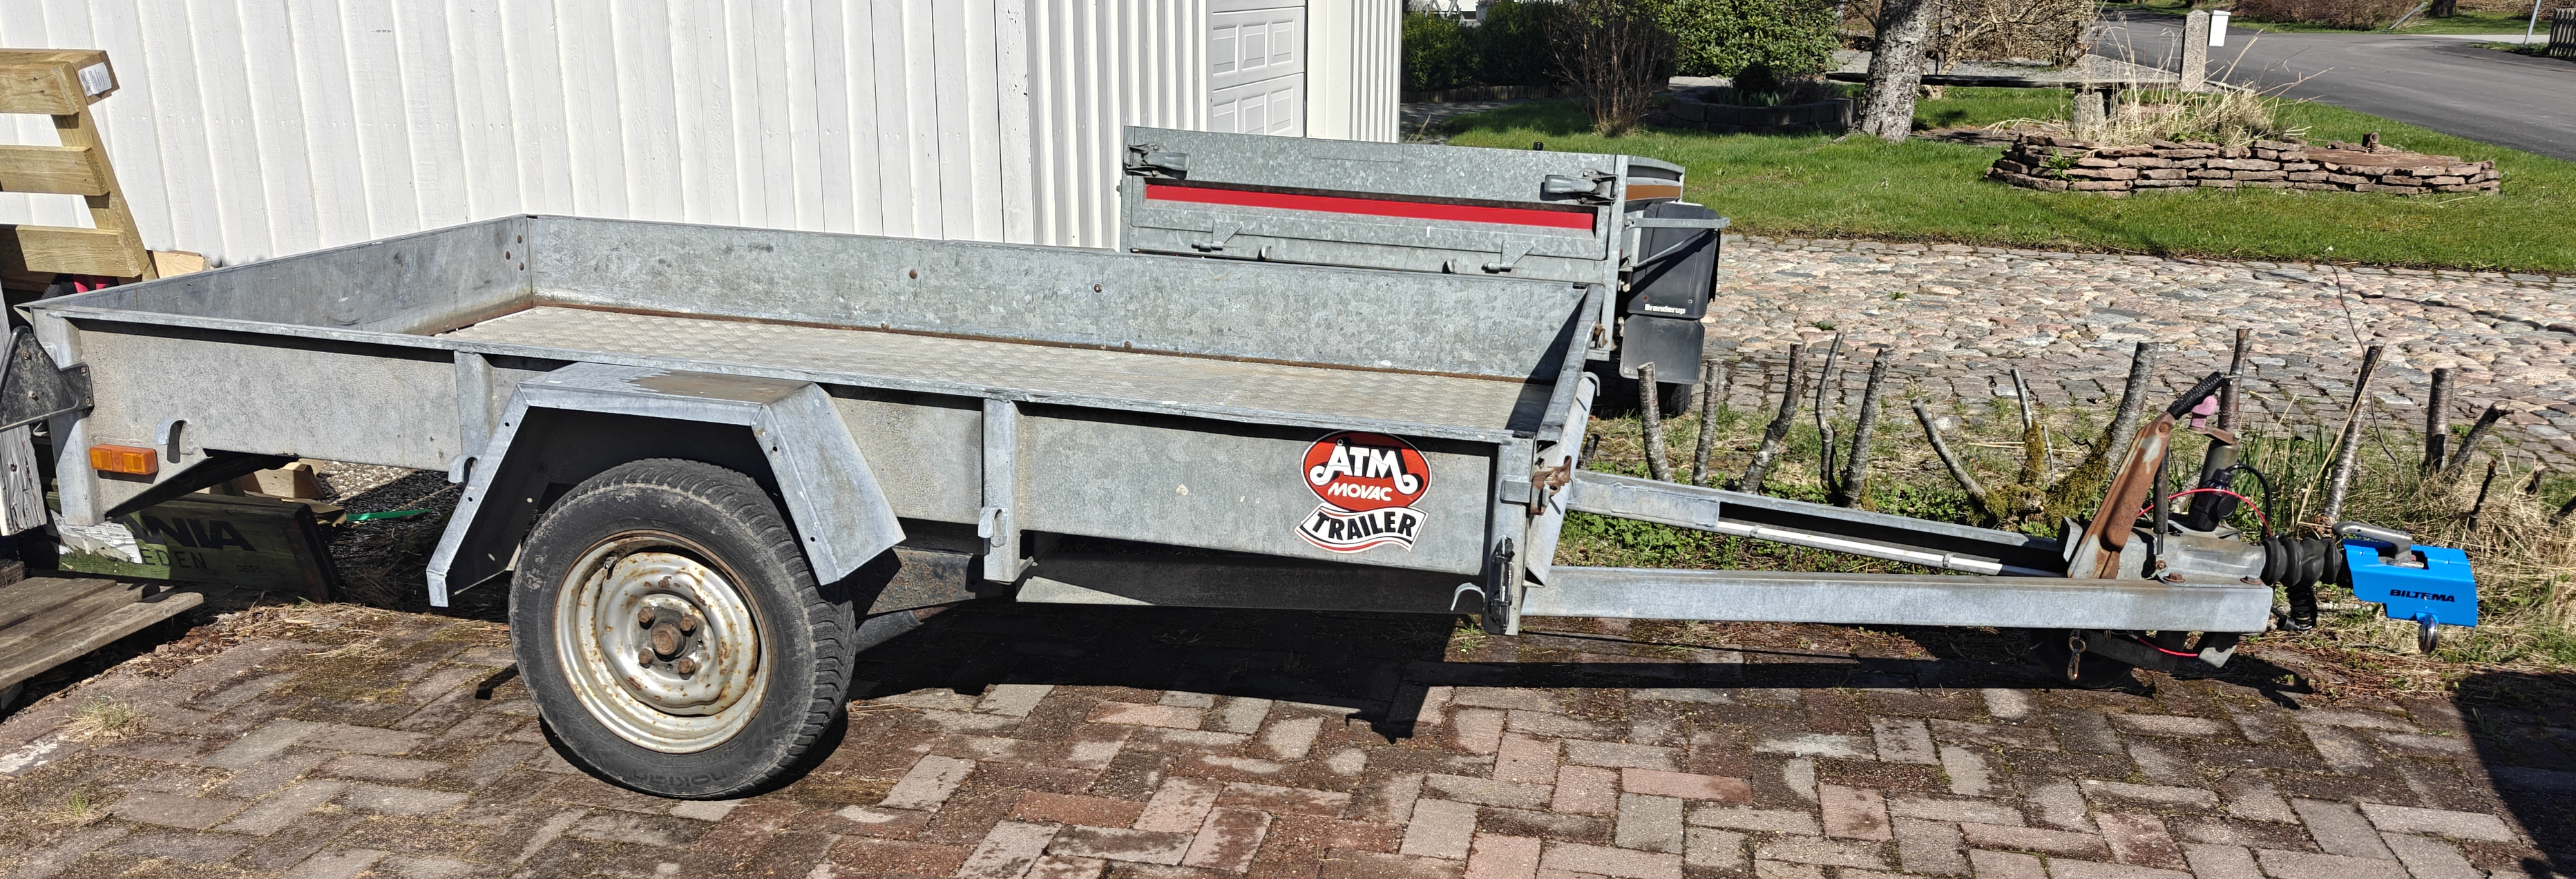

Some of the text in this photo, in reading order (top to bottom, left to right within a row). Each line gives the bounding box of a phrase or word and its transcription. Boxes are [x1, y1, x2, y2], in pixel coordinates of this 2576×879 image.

[1645, 304, 1686, 315] Brenderup
[1328, 482, 1393, 501] MOVAC
[1312, 511, 1416, 541] TRAILER
[2389, 589, 2455, 603] BILTEMA
